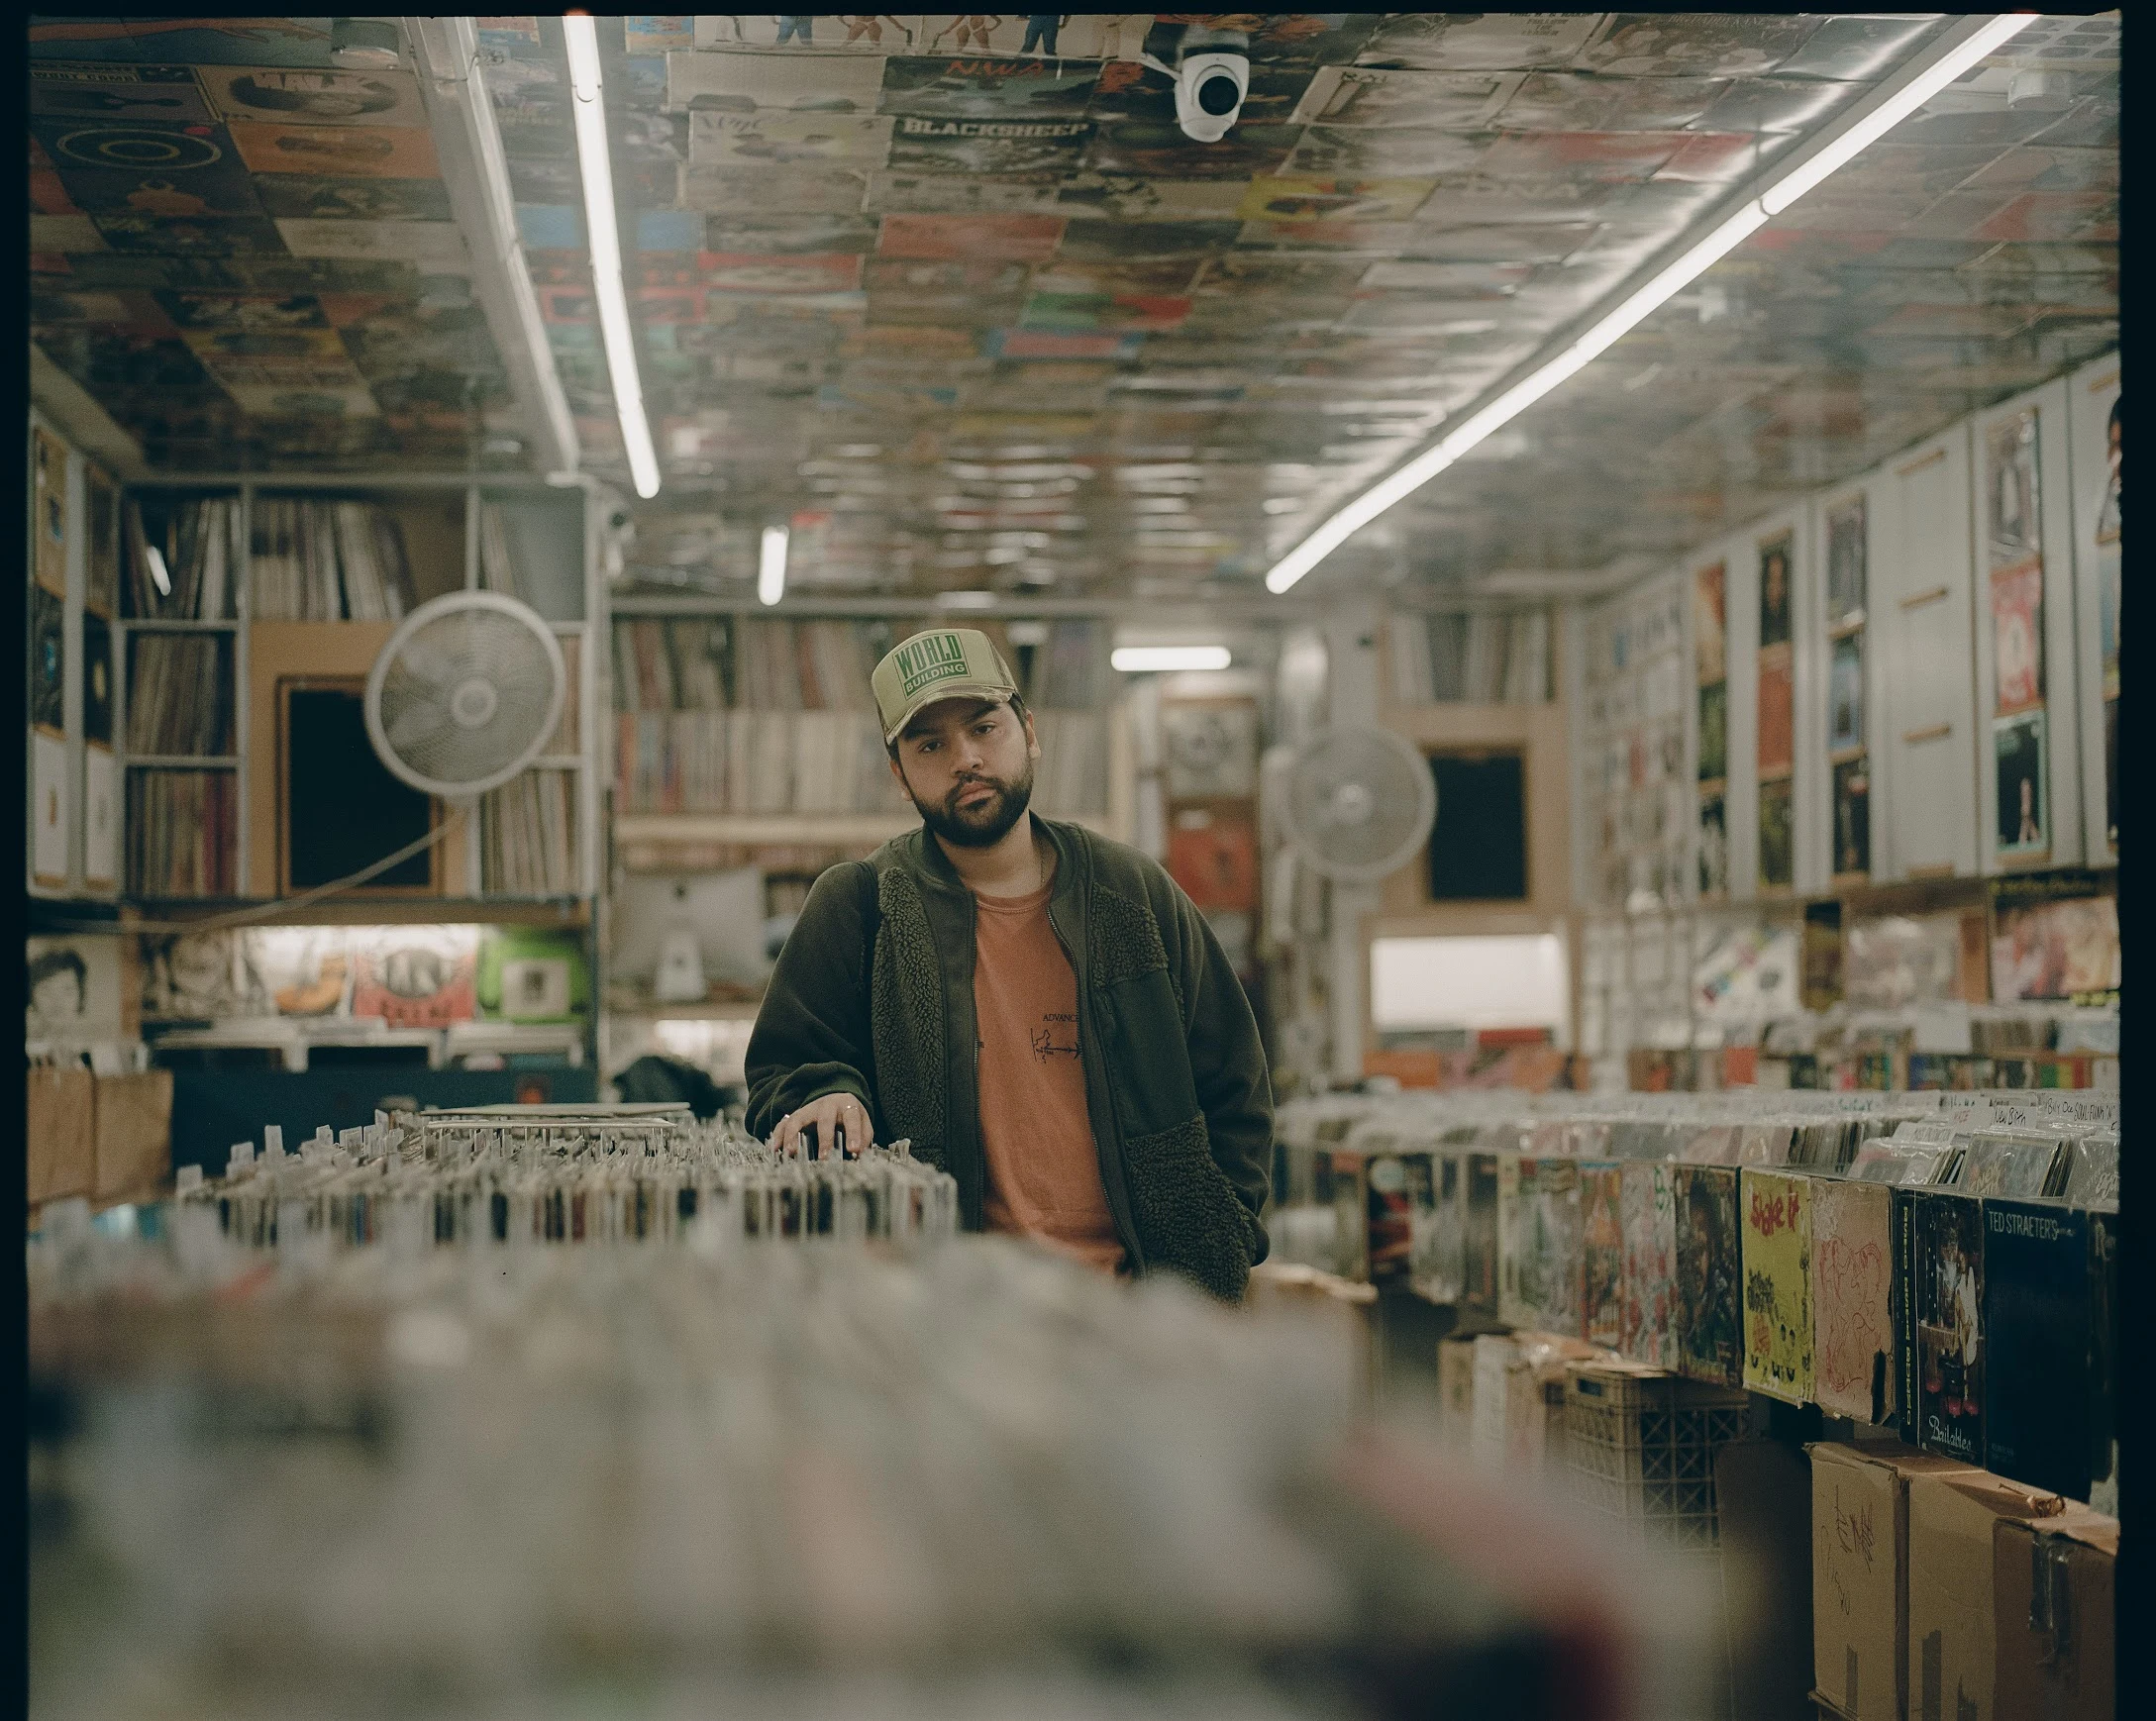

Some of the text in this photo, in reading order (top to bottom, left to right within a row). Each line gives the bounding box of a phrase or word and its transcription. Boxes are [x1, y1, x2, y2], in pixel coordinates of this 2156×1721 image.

[894, 634, 963, 680] WORLD
[905, 662, 967, 693] BUILDING
[1988, 1210, 2005, 1234] TED
[2005, 1212, 2059, 1242] STRAETER'S
